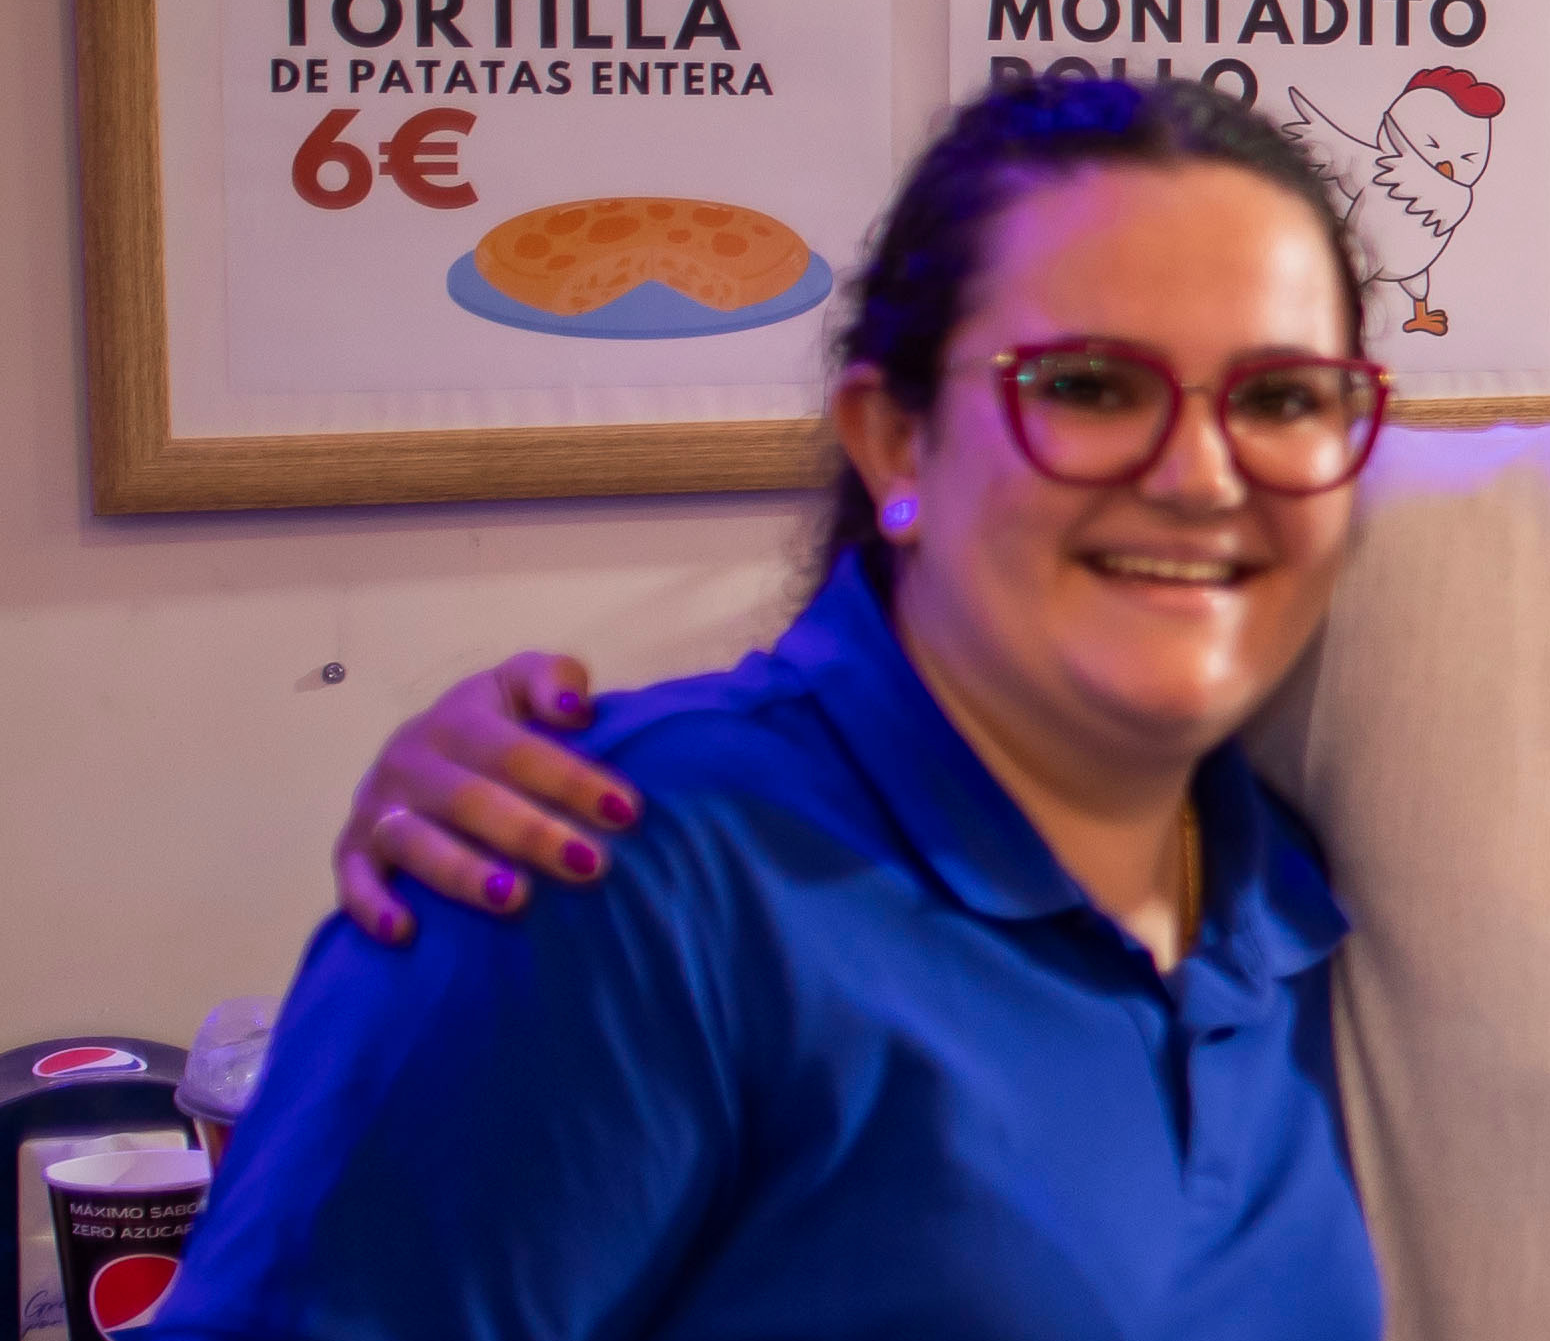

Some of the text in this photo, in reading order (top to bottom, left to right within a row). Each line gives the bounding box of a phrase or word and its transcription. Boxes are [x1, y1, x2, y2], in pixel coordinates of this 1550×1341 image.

[272, 59, 774, 96] DE PATATAS ENTERA
[292, 108, 478, 209] 6€
[72, 1223, 115, 1238] ZERO
